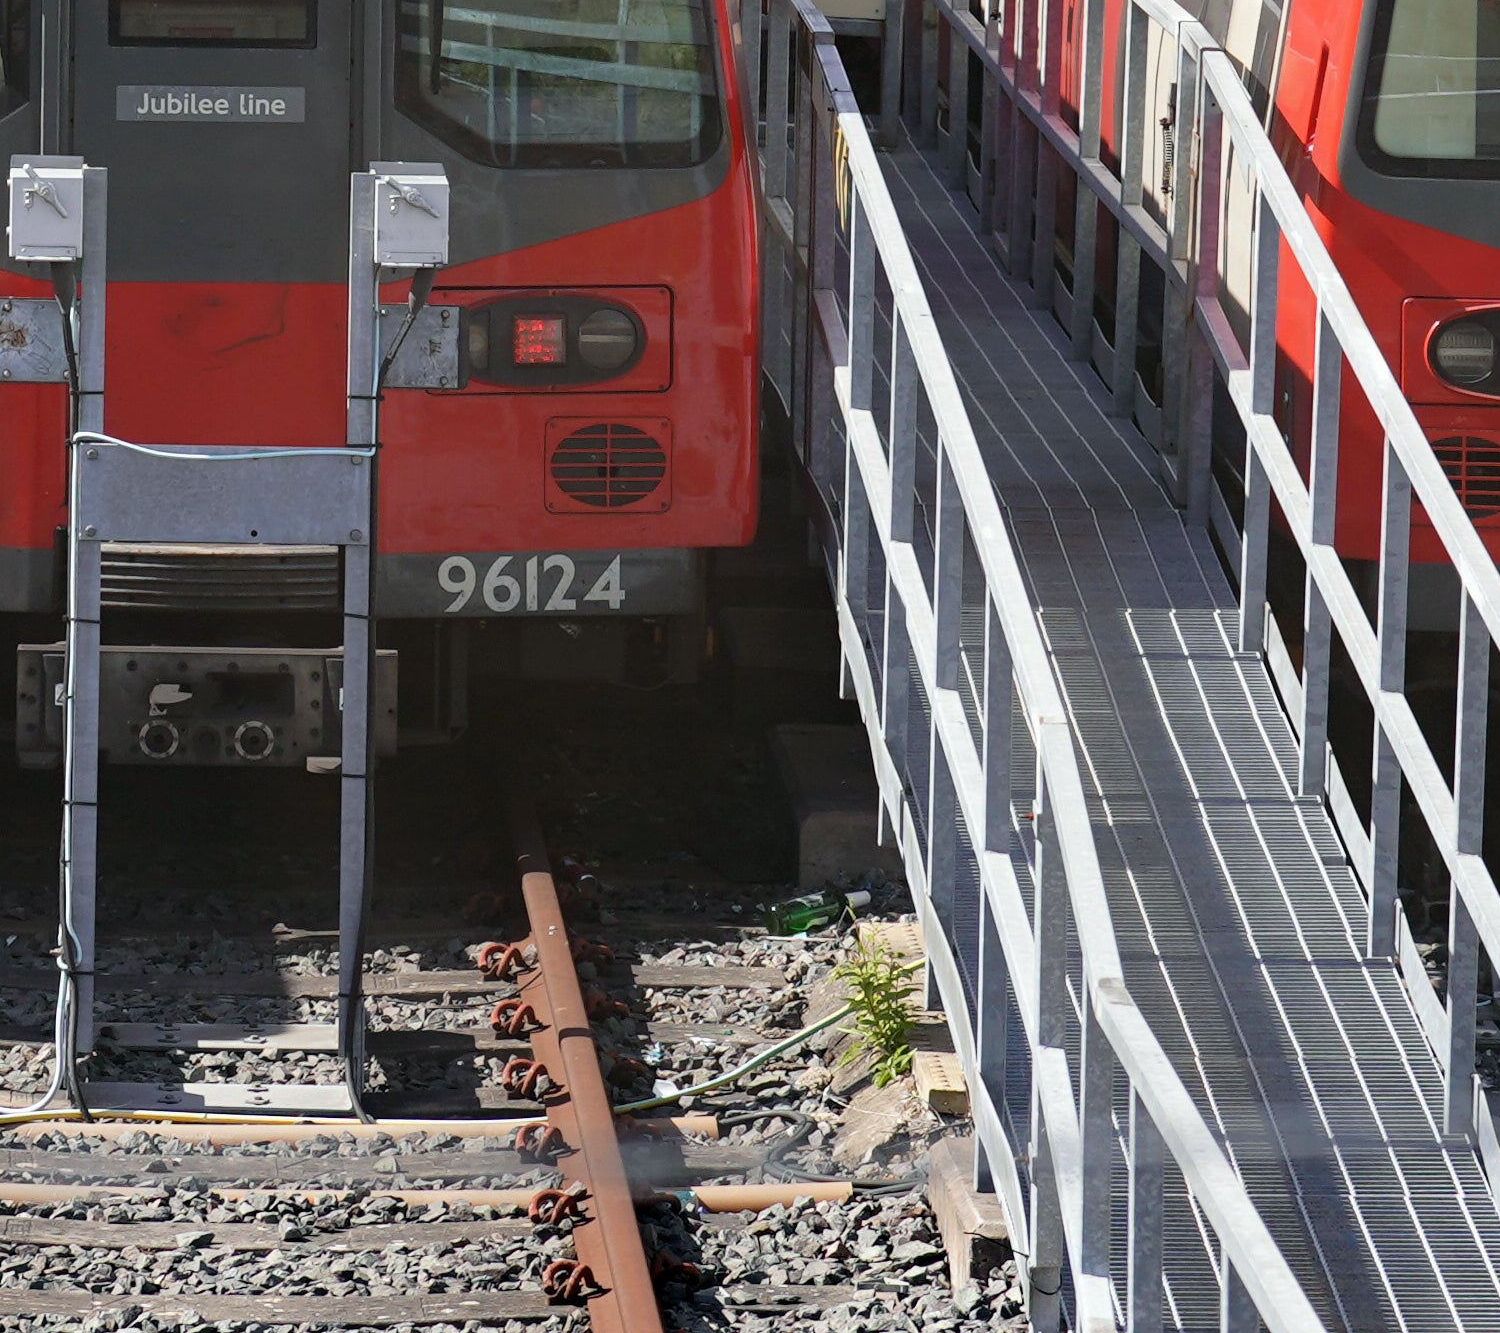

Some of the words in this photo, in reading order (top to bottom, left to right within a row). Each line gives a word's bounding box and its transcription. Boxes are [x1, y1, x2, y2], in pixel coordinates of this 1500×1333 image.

[136, 93, 230, 116] Jubilee
[239, 93, 287, 116] line
[437, 553, 627, 614] 96124
